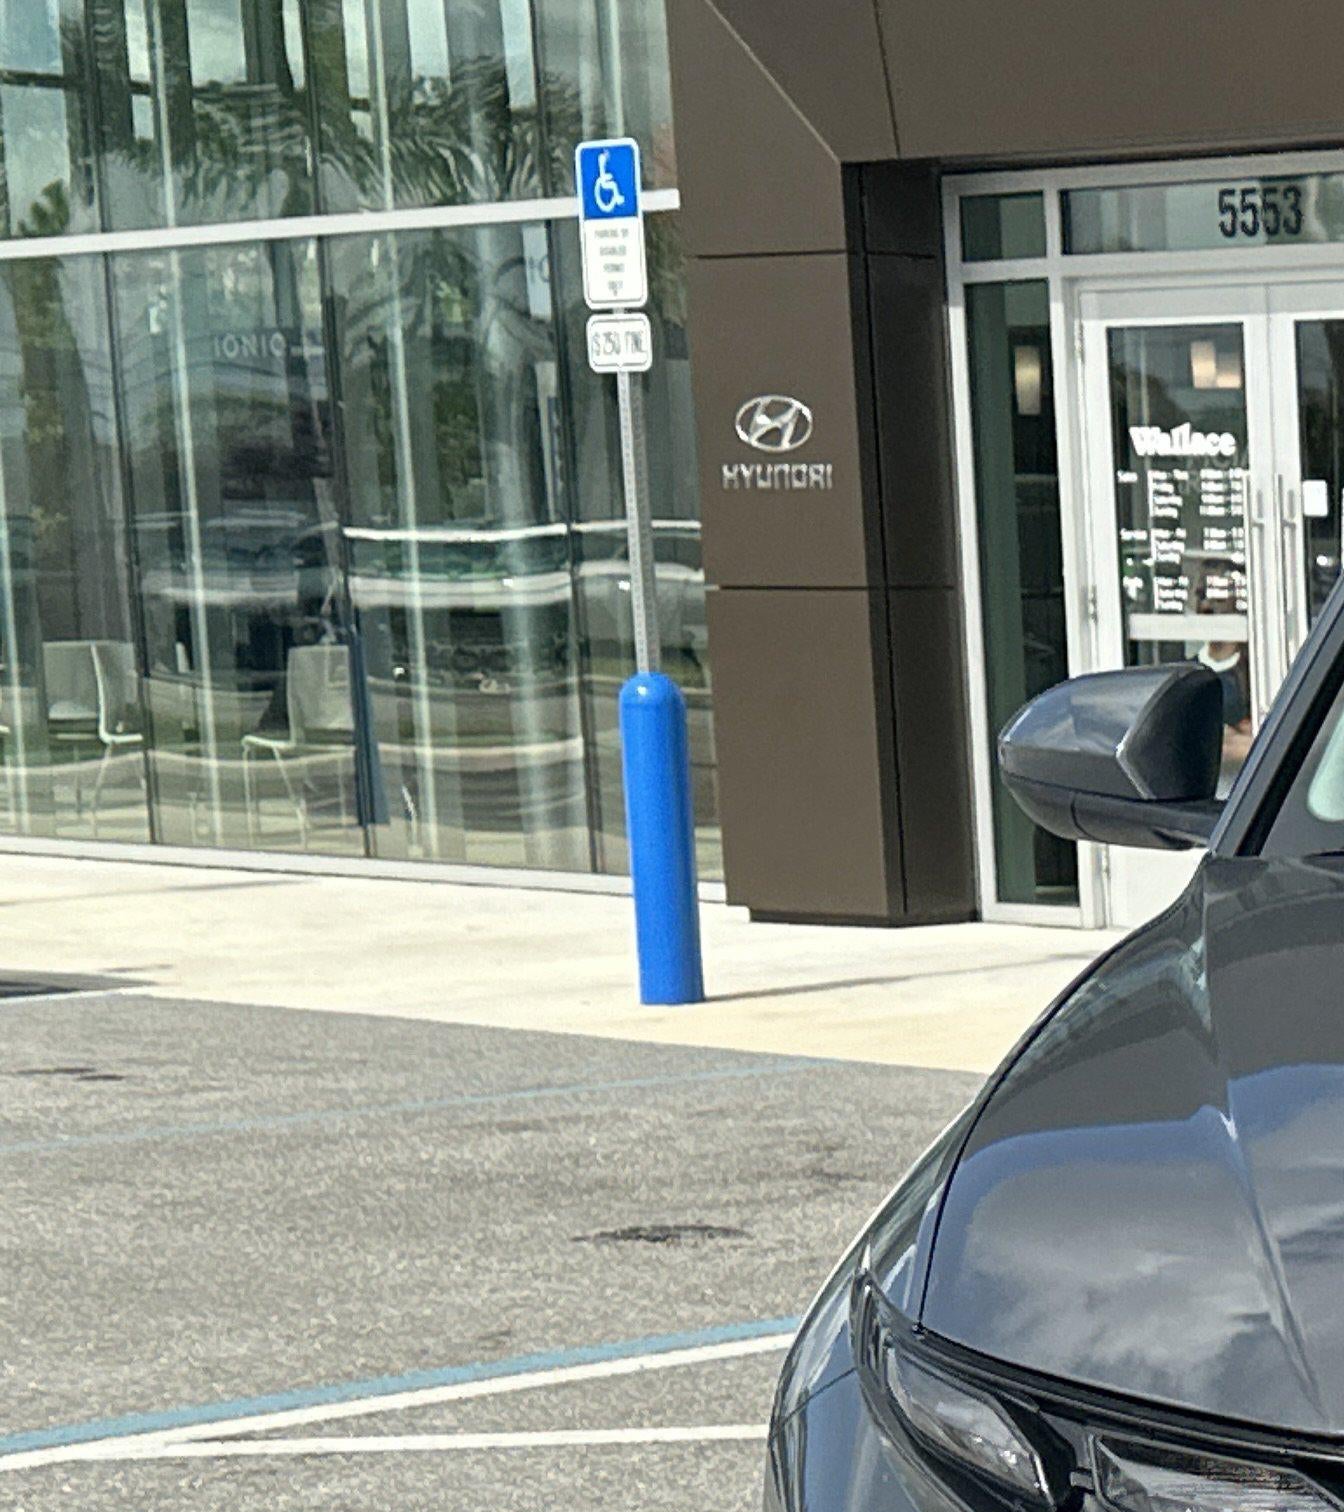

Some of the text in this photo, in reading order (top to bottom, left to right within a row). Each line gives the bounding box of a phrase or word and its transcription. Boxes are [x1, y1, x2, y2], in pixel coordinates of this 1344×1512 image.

[1218, 185, 1303, 237] 5553
[1128, 421, 1237, 457] Wallace
[721, 463, 832, 490] HYUNDAI
